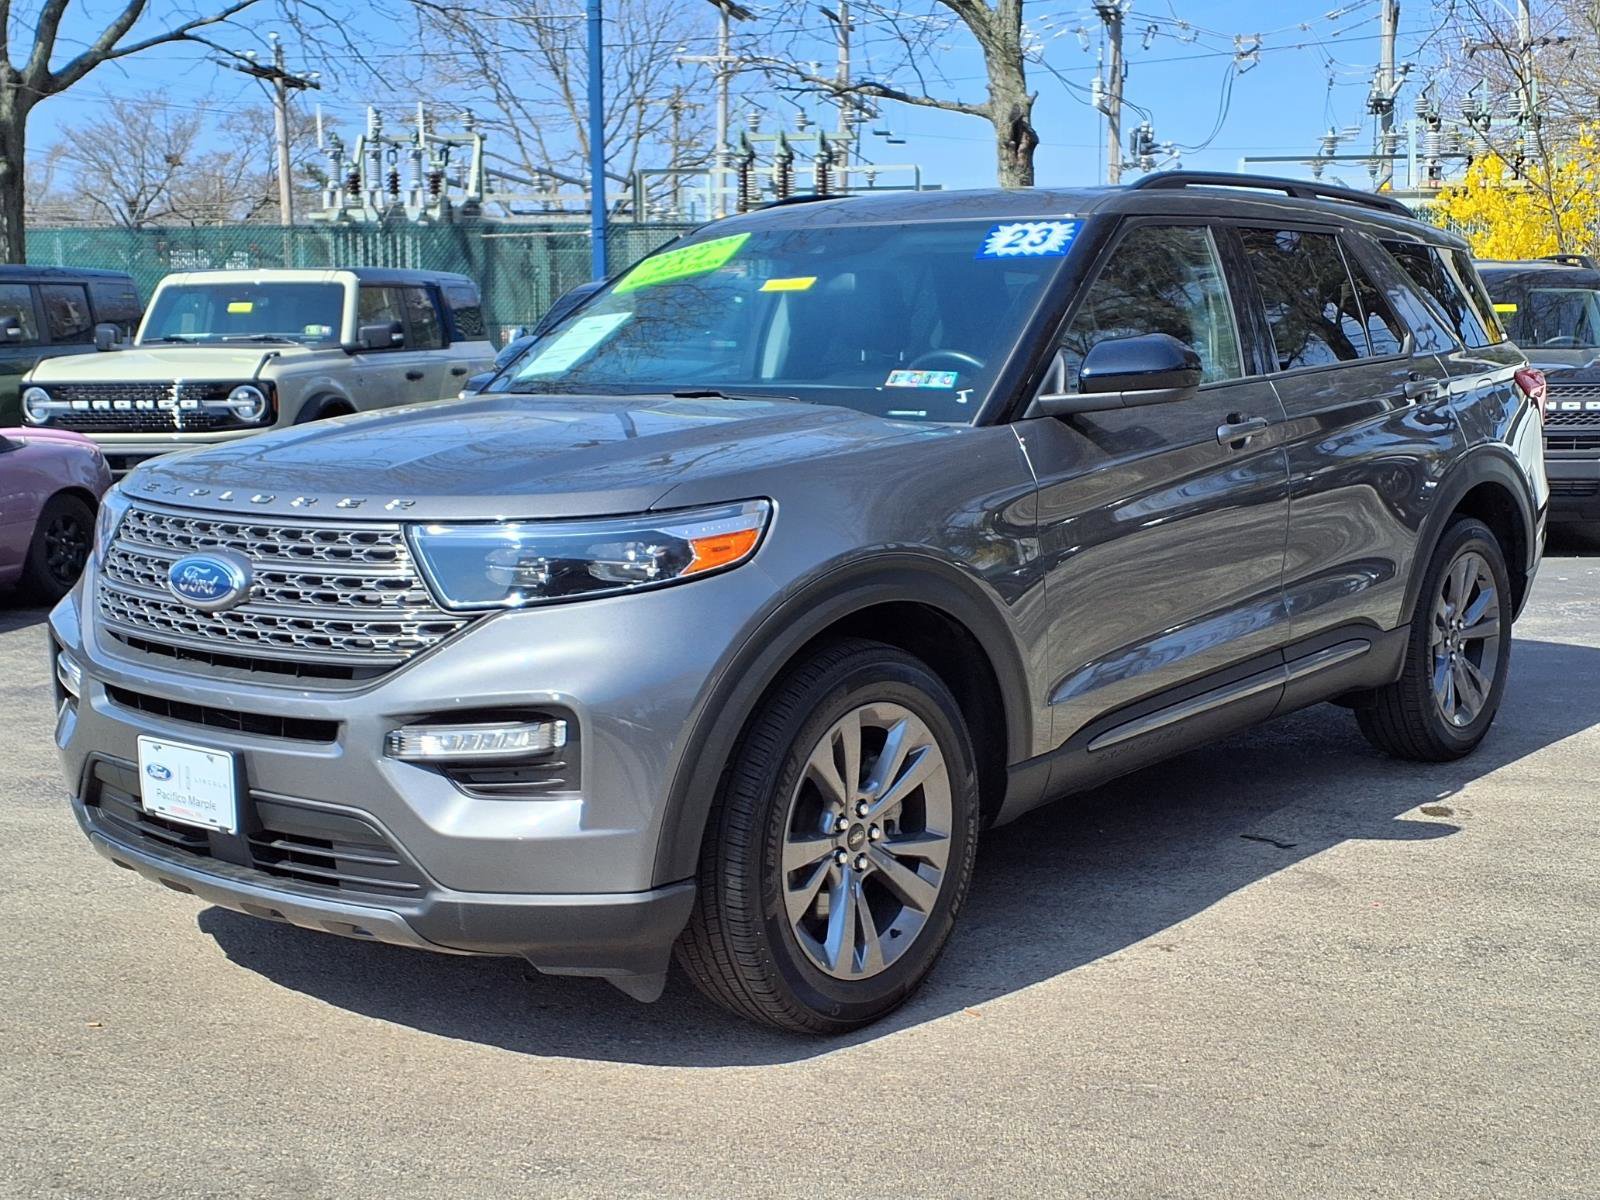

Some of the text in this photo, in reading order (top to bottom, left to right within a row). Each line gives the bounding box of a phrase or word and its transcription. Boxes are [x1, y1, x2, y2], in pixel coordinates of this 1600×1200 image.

[1003, 227, 1054, 248] 23
[71, 400, 198, 410] BRONCO
[142, 482, 416, 511] EXPLORER
[178, 565, 220, 595] Ford
[156, 788, 217, 811] Pacifico Marple
